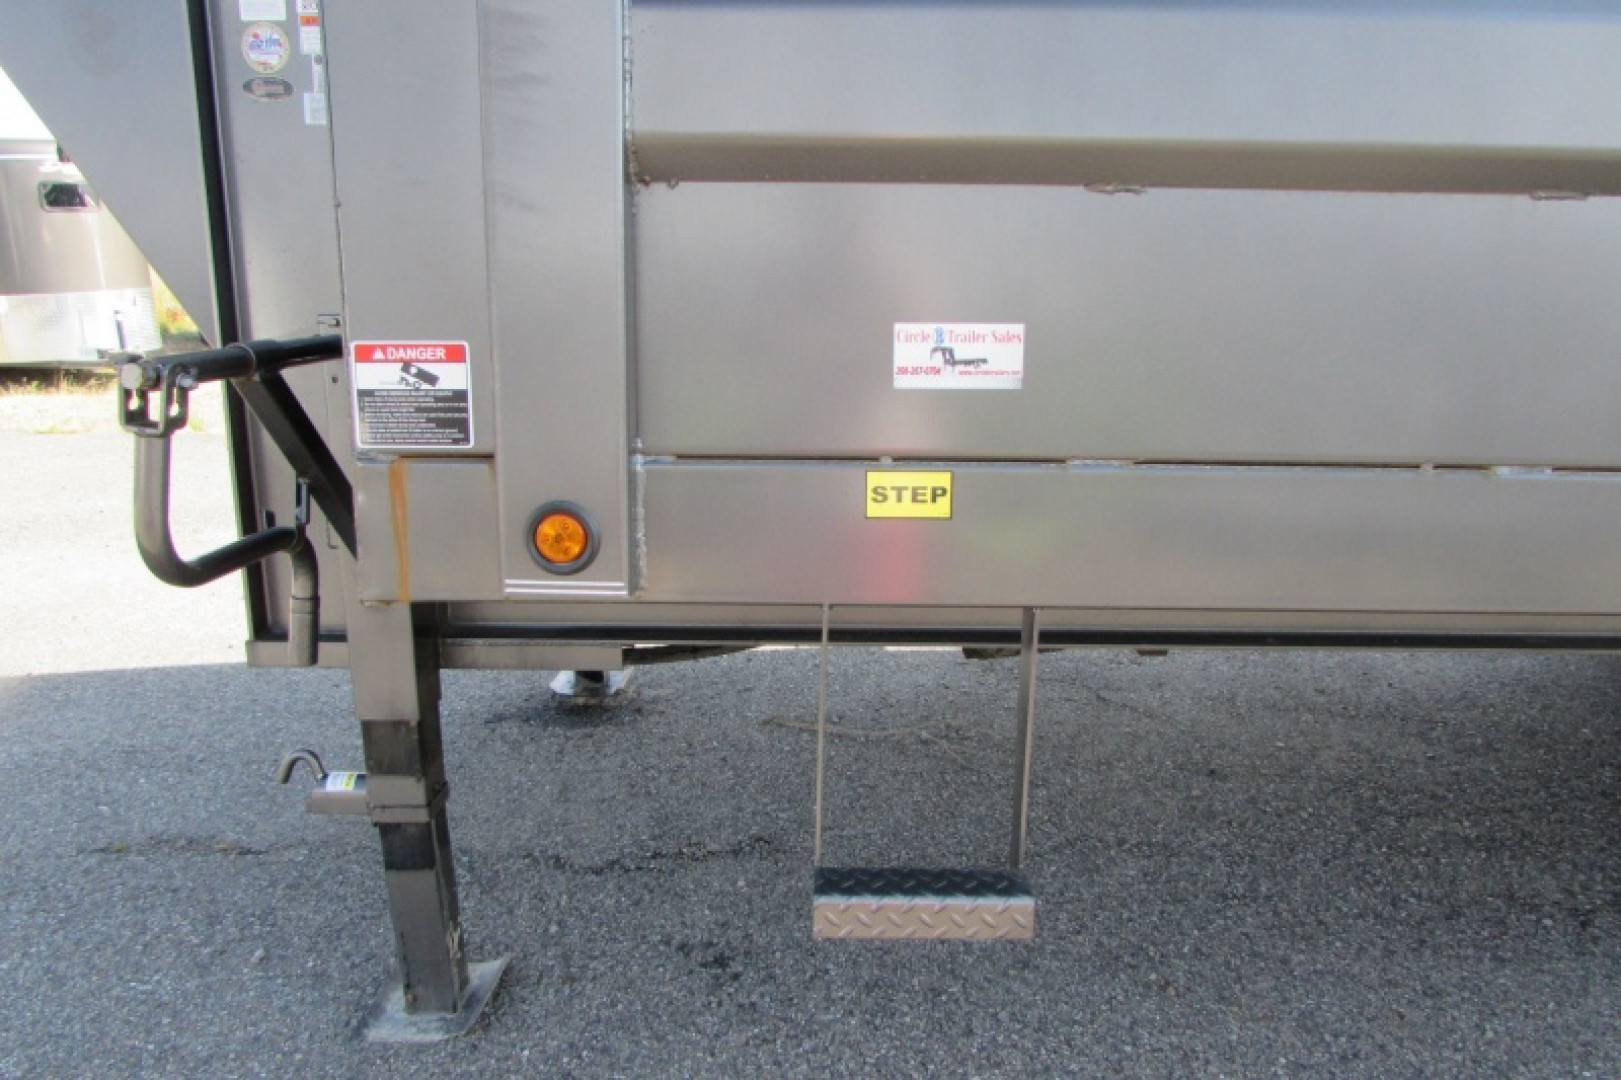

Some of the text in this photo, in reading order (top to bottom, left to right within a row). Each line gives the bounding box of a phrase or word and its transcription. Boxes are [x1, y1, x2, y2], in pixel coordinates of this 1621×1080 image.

[897, 329, 930, 344] Circle
[948, 329, 988, 344] Trailer
[991, 329, 1022, 344] Sales
[386, 347, 446, 360] DANGER
[871, 485, 948, 504] STEP
